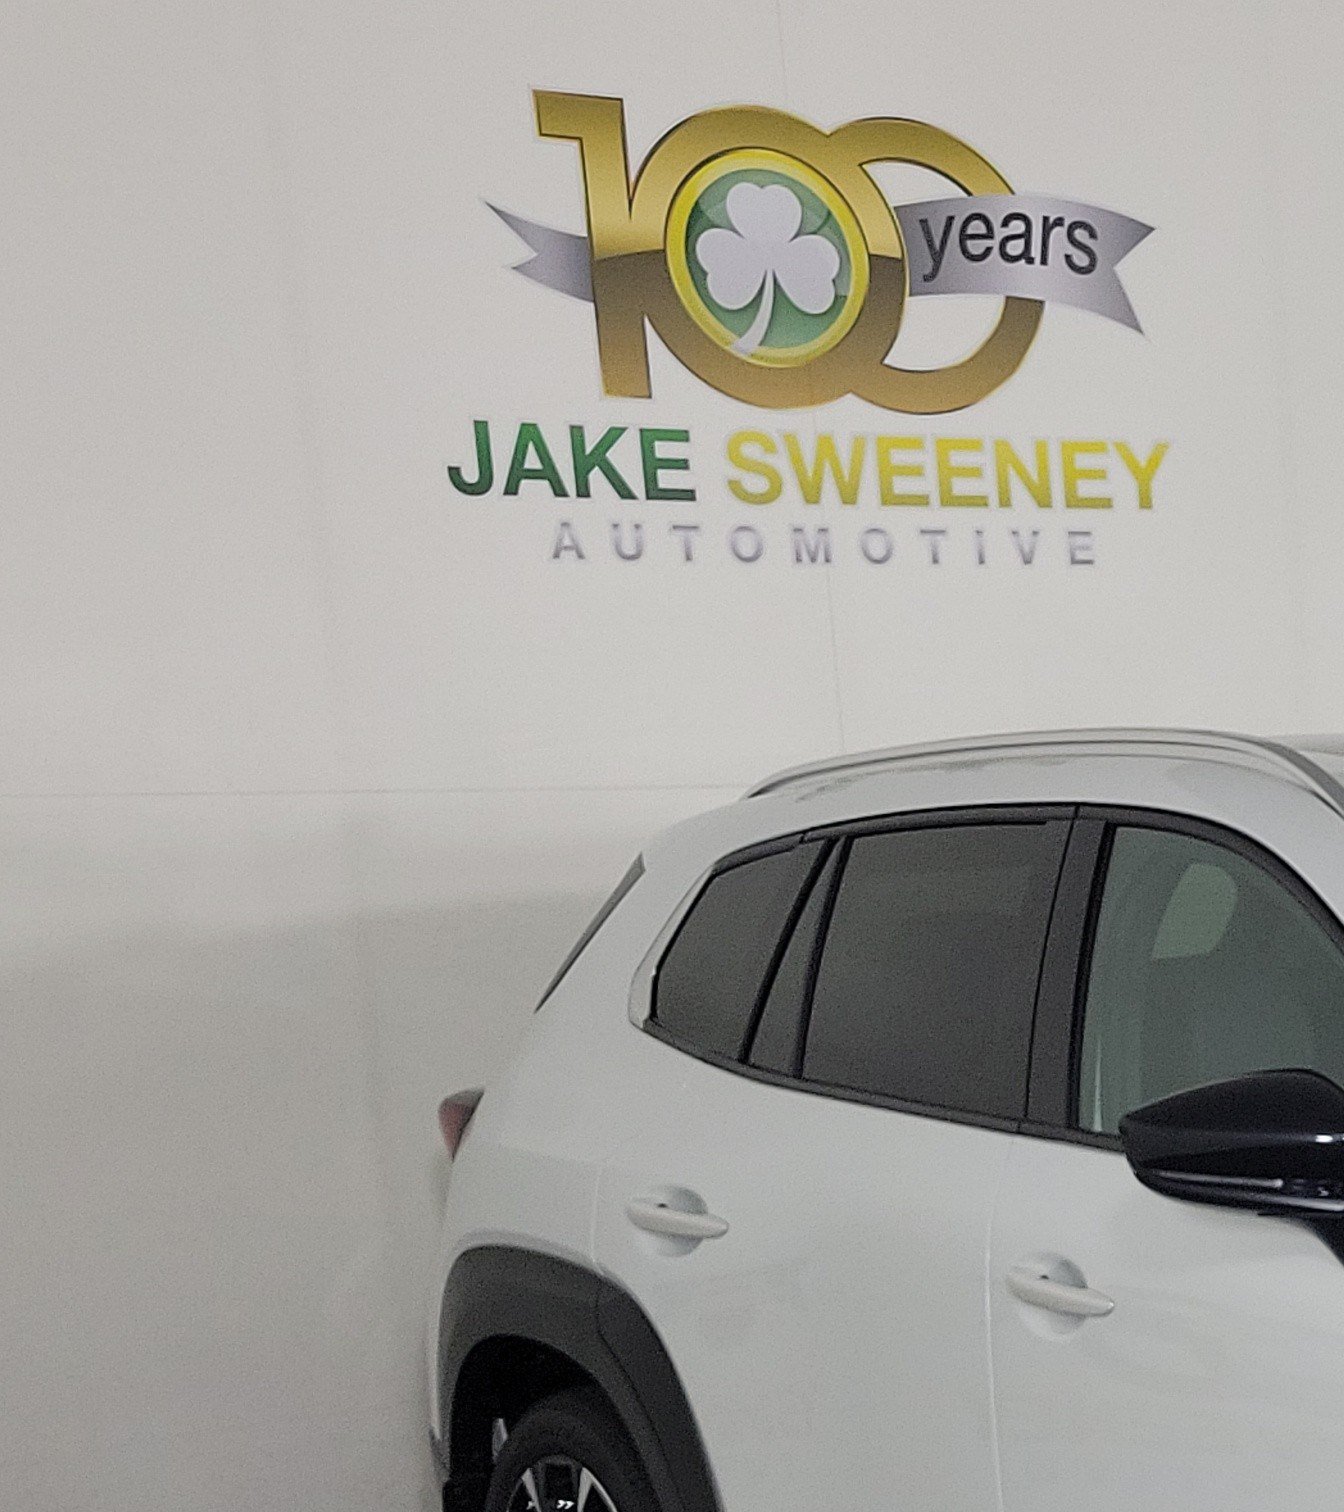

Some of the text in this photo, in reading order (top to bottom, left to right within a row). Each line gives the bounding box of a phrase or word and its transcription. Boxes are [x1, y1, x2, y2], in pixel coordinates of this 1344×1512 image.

[532, 88, 1099, 415] 100 years
[447, 420, 1169, 510] JAKE SWEENEY
[552, 522, 1097, 566] AUTOMOTIVE
